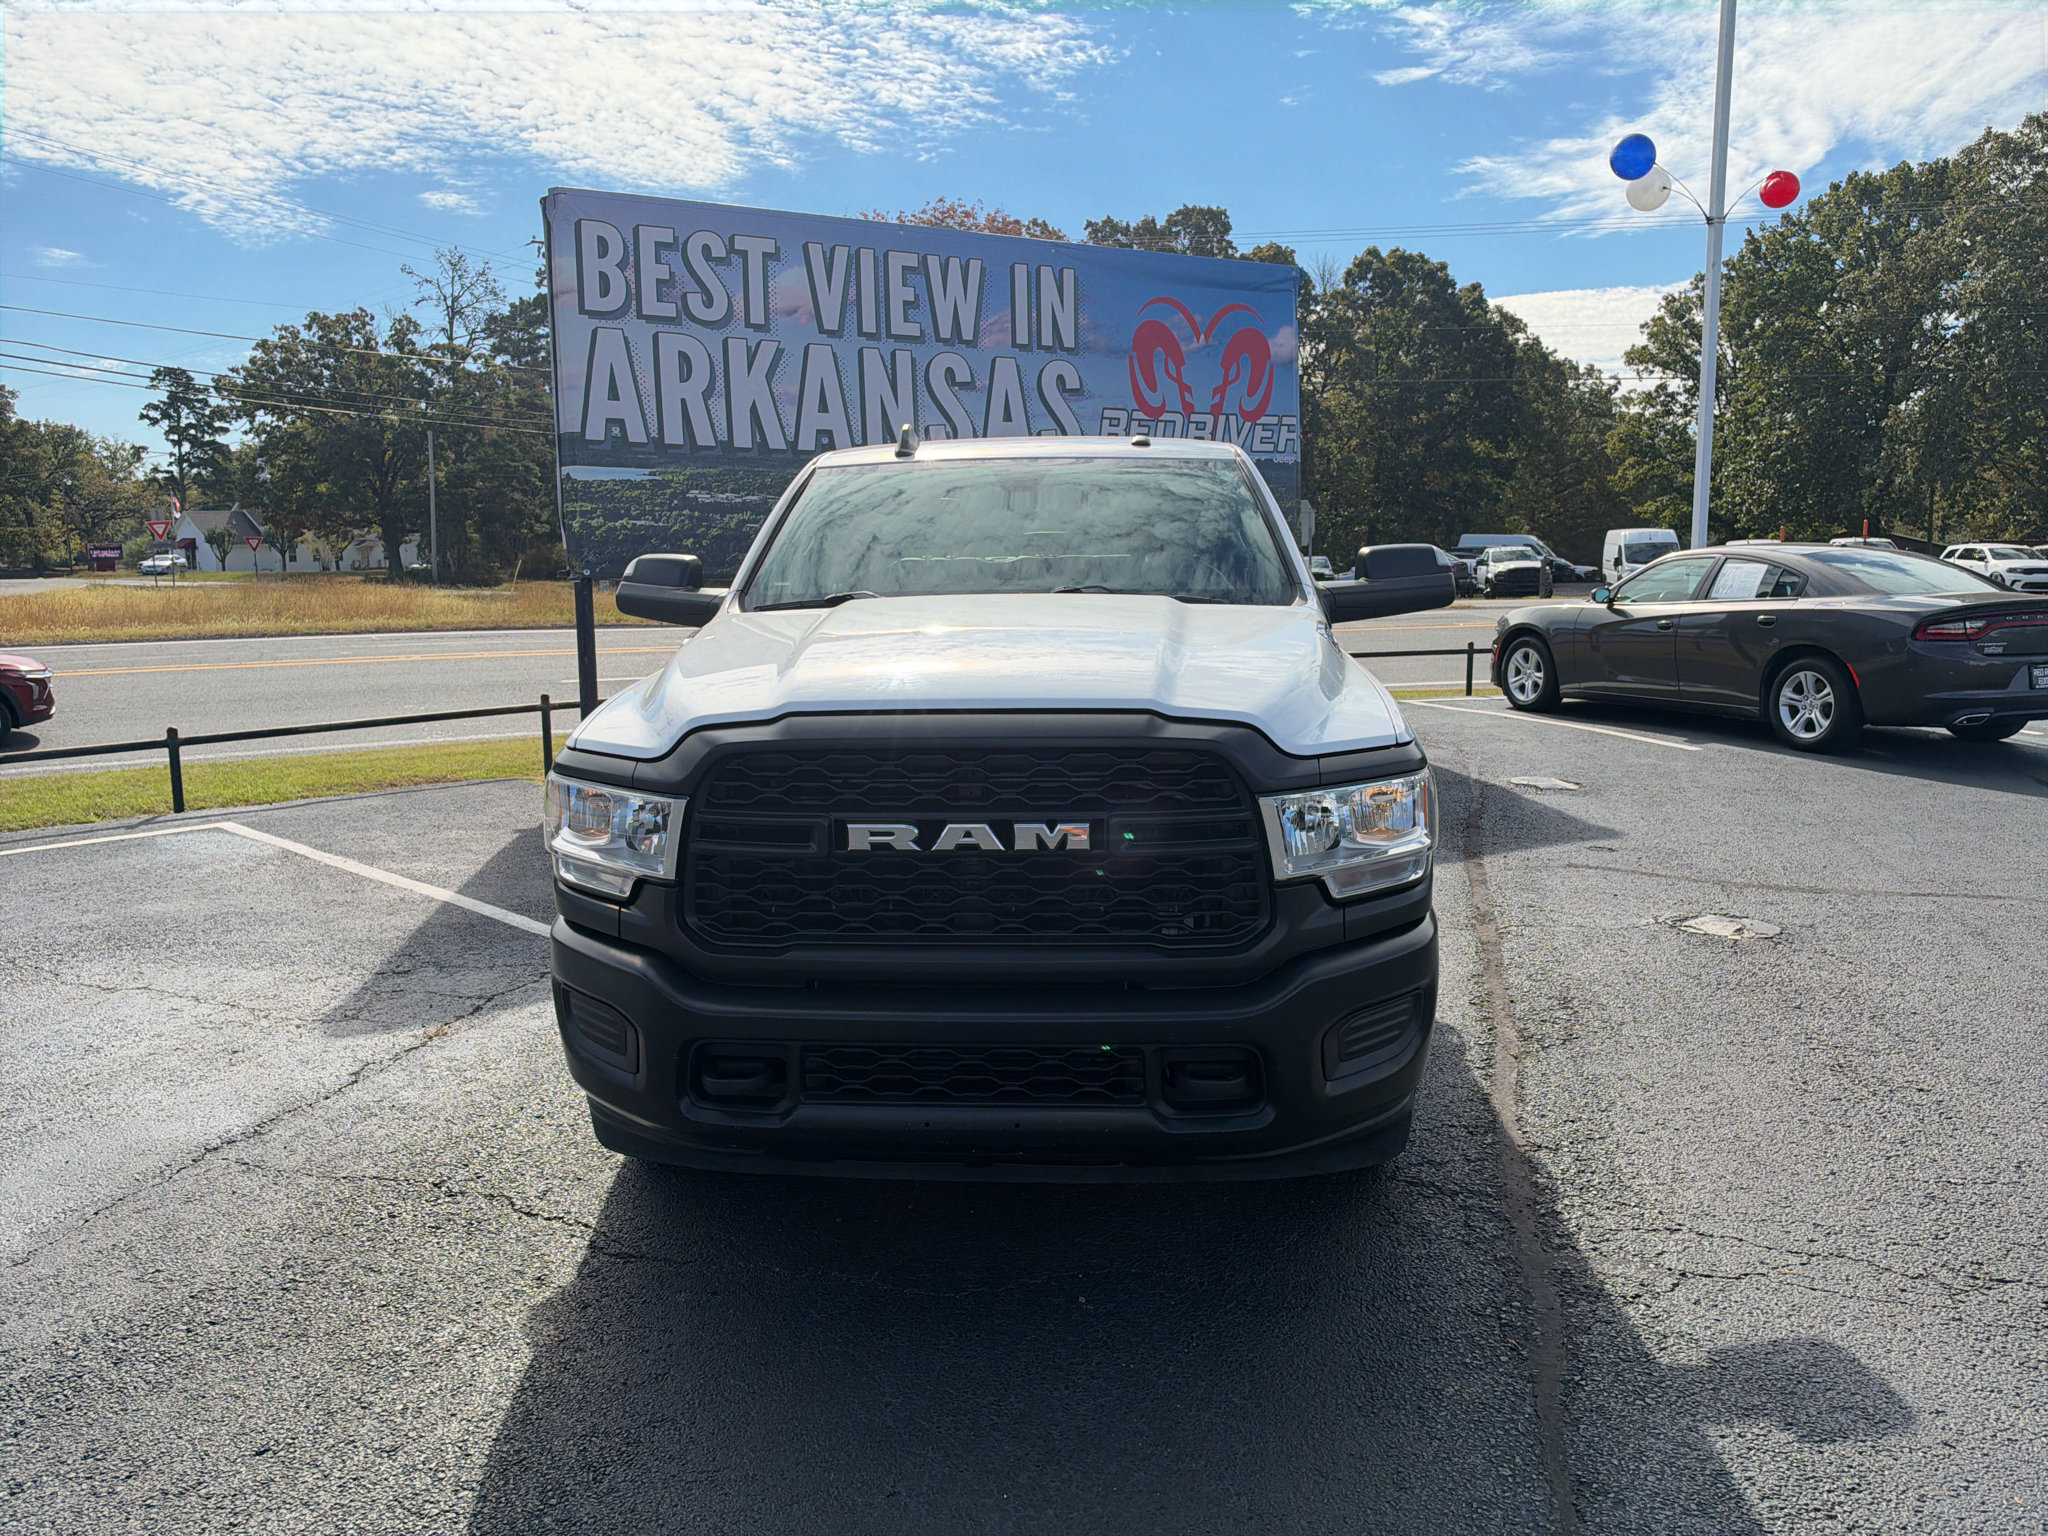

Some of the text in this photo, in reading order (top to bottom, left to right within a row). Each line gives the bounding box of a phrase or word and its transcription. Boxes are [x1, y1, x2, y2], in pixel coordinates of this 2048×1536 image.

[575, 218, 1076, 351] BEST VIEW IN
[581, 326, 1082, 449] ARKANSAS
[1273, 453, 1295, 465] Jeep
[847, 823, 1090, 851] RAM
